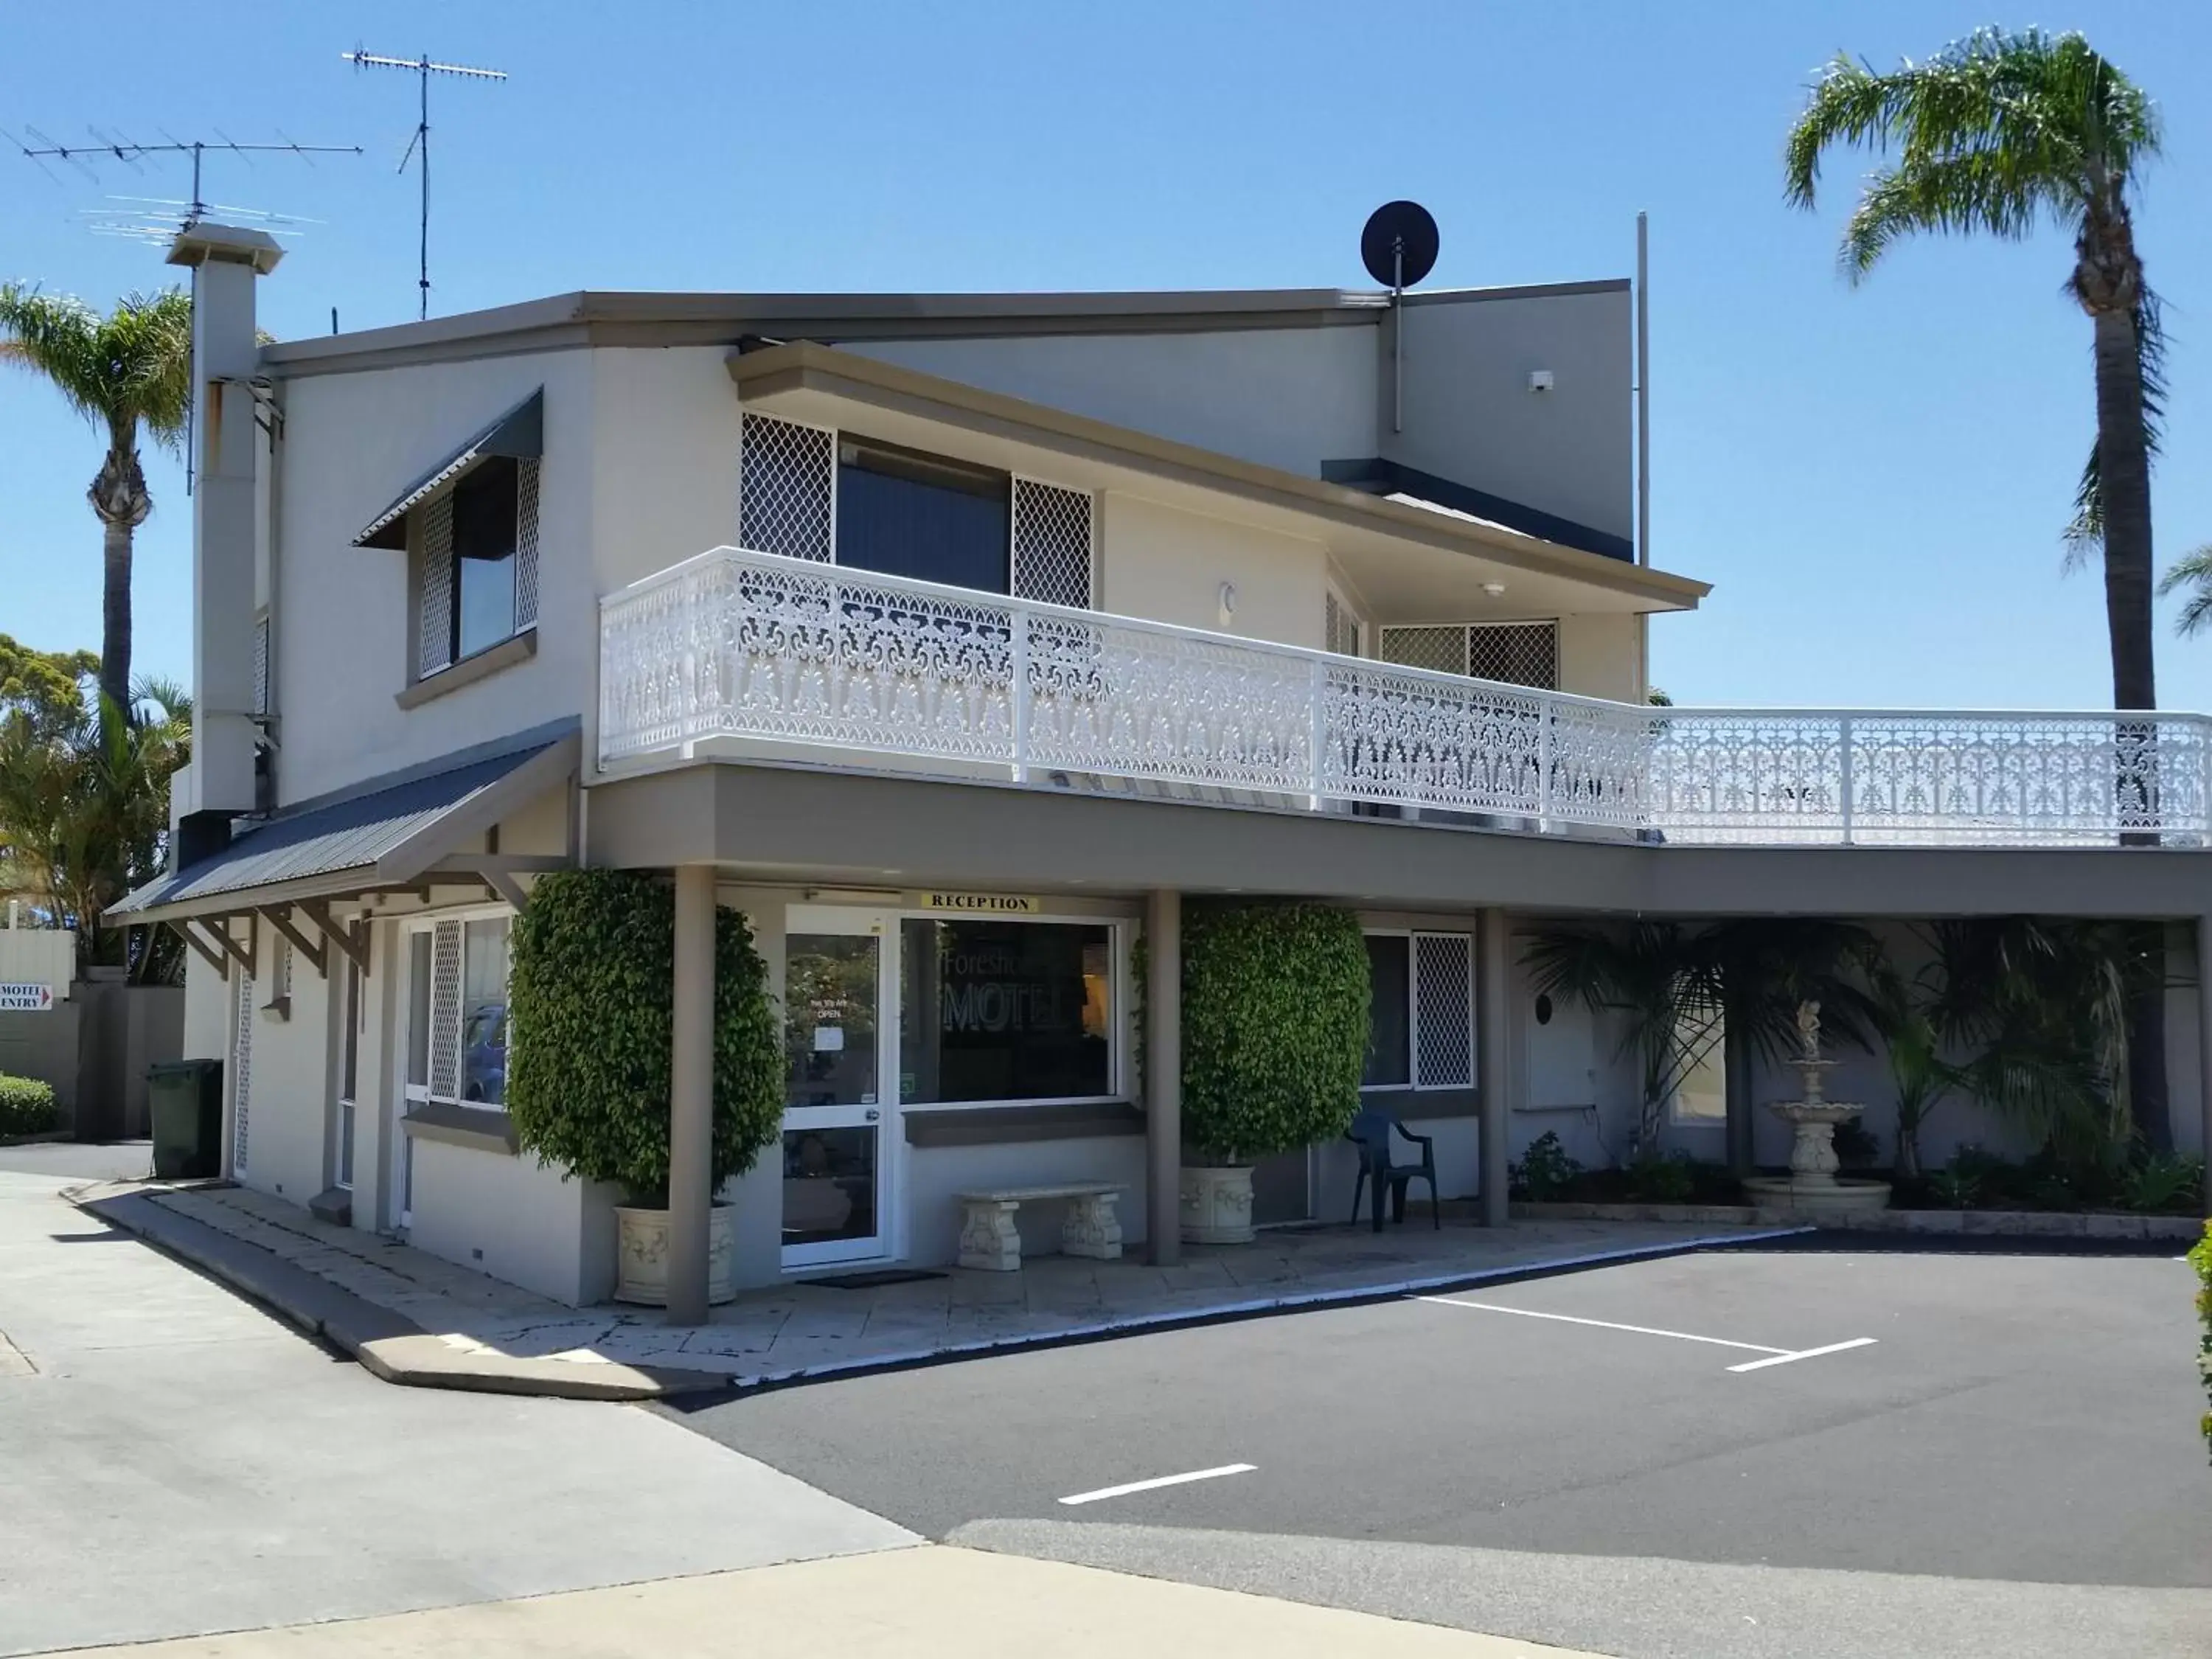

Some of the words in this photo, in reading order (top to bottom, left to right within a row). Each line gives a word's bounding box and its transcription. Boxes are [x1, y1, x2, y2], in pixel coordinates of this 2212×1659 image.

[932, 894, 1029, 911] RECEPTION
[943, 947, 1023, 976] Foresho
[1, 986, 39, 995] MOTEL
[1, 998, 38, 1007] ENTRY
[944, 983, 1068, 1033] MOTEL
[818, 1010, 841, 1018] OPEN
